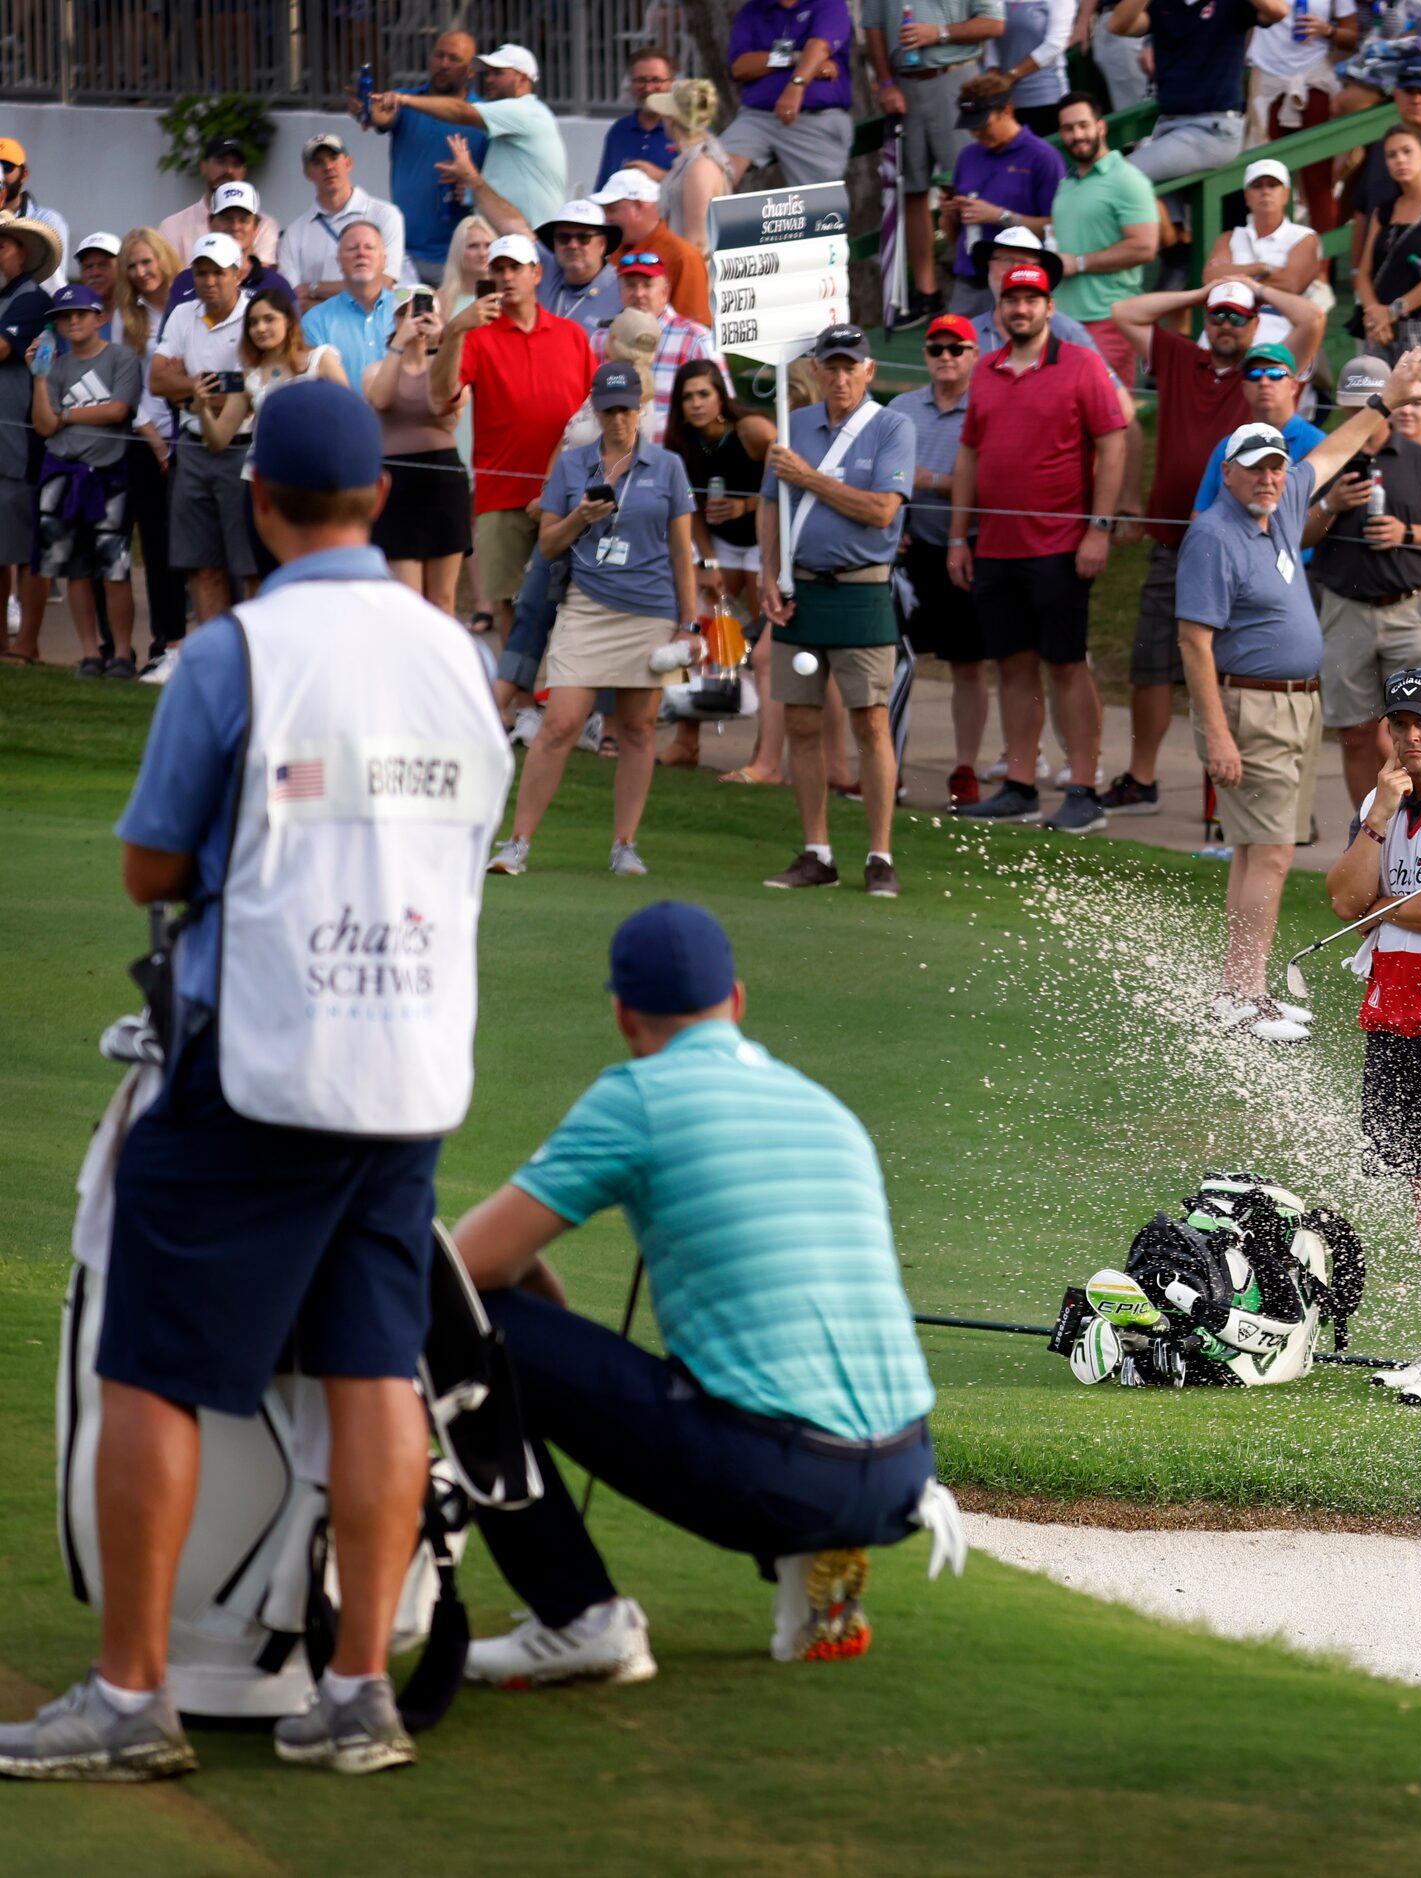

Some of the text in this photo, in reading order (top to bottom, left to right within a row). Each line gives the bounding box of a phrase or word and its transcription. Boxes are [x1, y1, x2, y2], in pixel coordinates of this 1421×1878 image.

[762, 194, 805, 219] charles
[761, 216, 807, 235] SCHWAB
[719, 252, 780, 282] MICKELSON
[720, 287, 756, 314] SPIETH
[720, 318, 759, 346] BERGER
[1344, 375, 1385, 389] Titleist
[308, 905, 434, 956] chaes
[1096, 1300, 1149, 1314] EPIC
[1054, 1306, 1070, 1349] ODYSSEY
